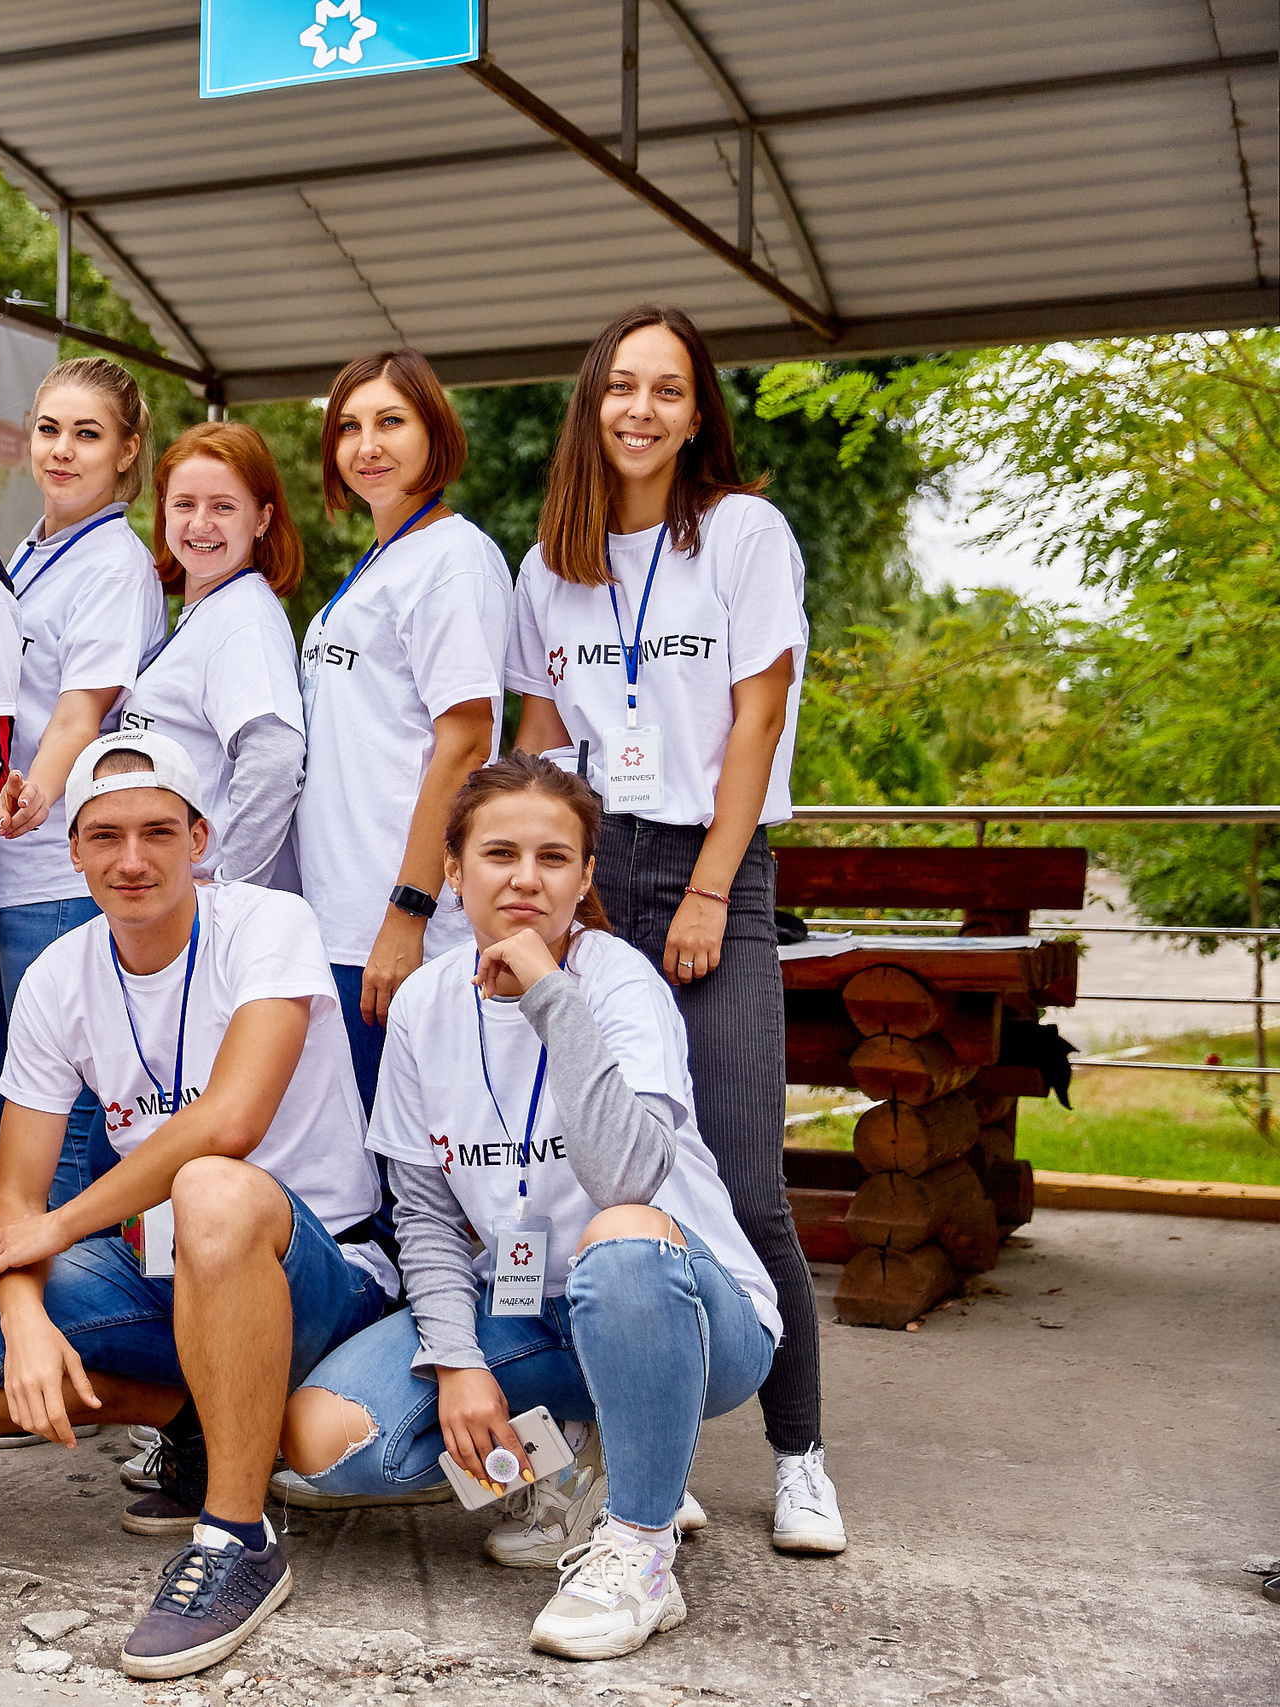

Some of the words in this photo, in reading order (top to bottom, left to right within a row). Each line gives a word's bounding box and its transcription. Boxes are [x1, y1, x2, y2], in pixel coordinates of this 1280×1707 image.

[610, 774, 656, 782] METINVEST
[618, 794, 650, 803] ЕВГЕНИЯ
[497, 1275, 541, 1283] METINVEST
[498, 1297, 535, 1306] НАДЕЖДА
